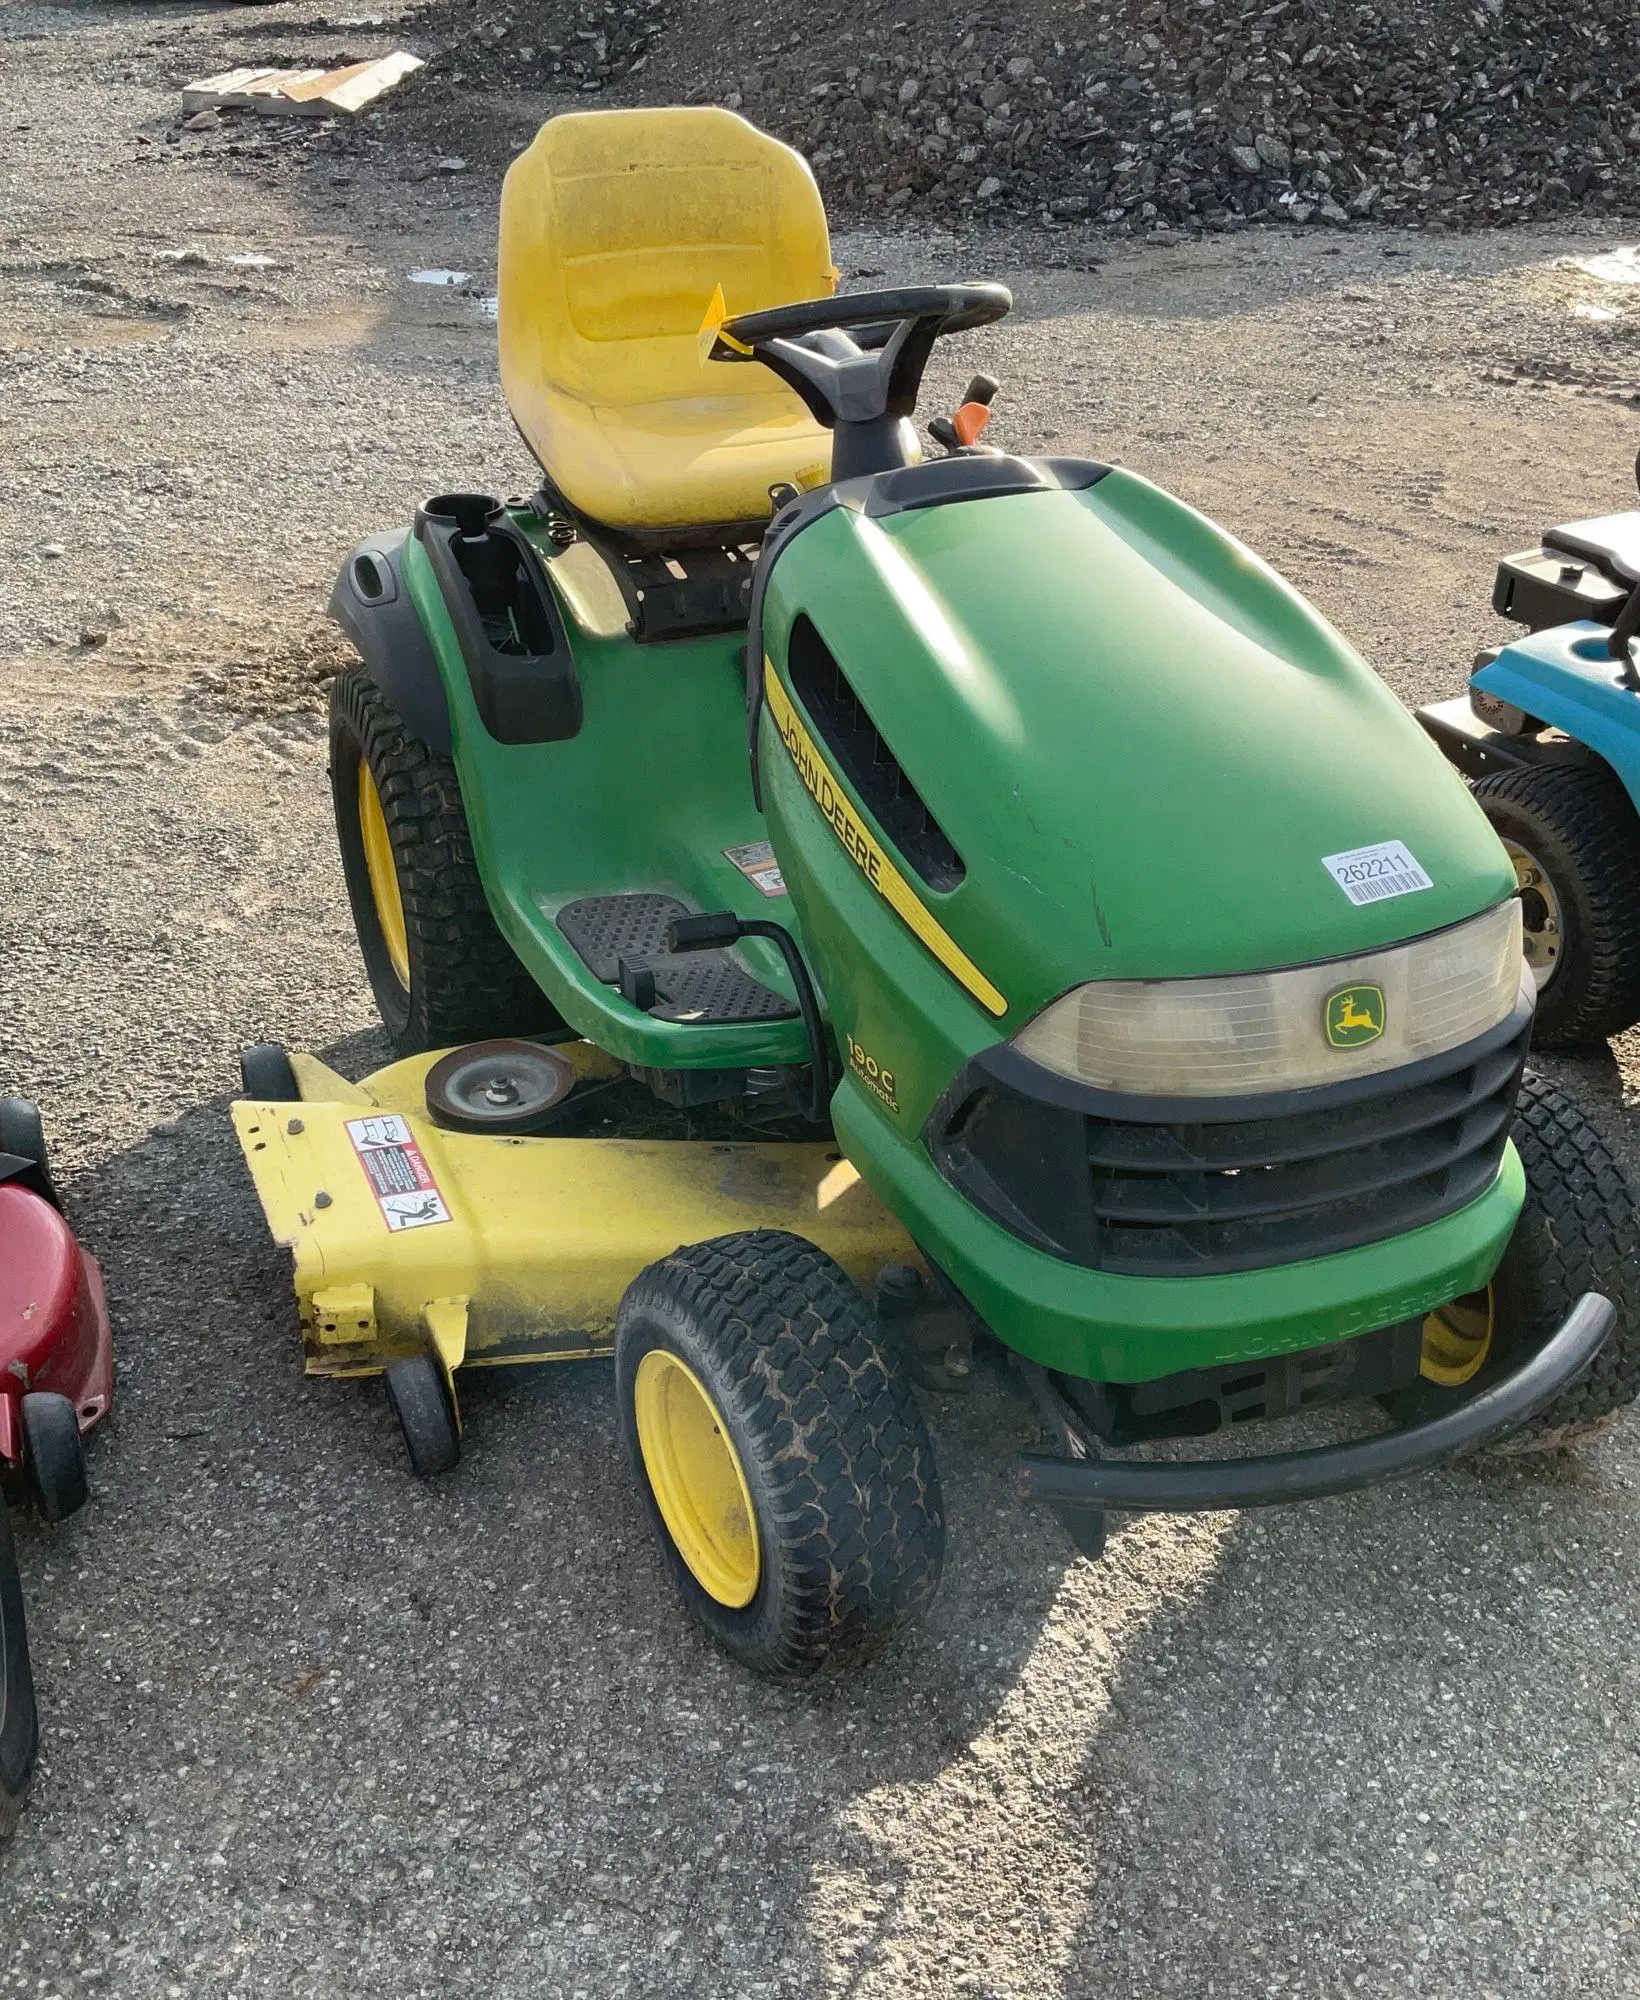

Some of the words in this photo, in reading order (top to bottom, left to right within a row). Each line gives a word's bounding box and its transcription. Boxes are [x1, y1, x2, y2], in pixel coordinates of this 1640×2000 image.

[782, 713, 819, 797] JOHN
[822, 776, 881, 886] DEERE
[1336, 853, 1409, 884] 262211
[410, 1155, 431, 1184] DANGER
